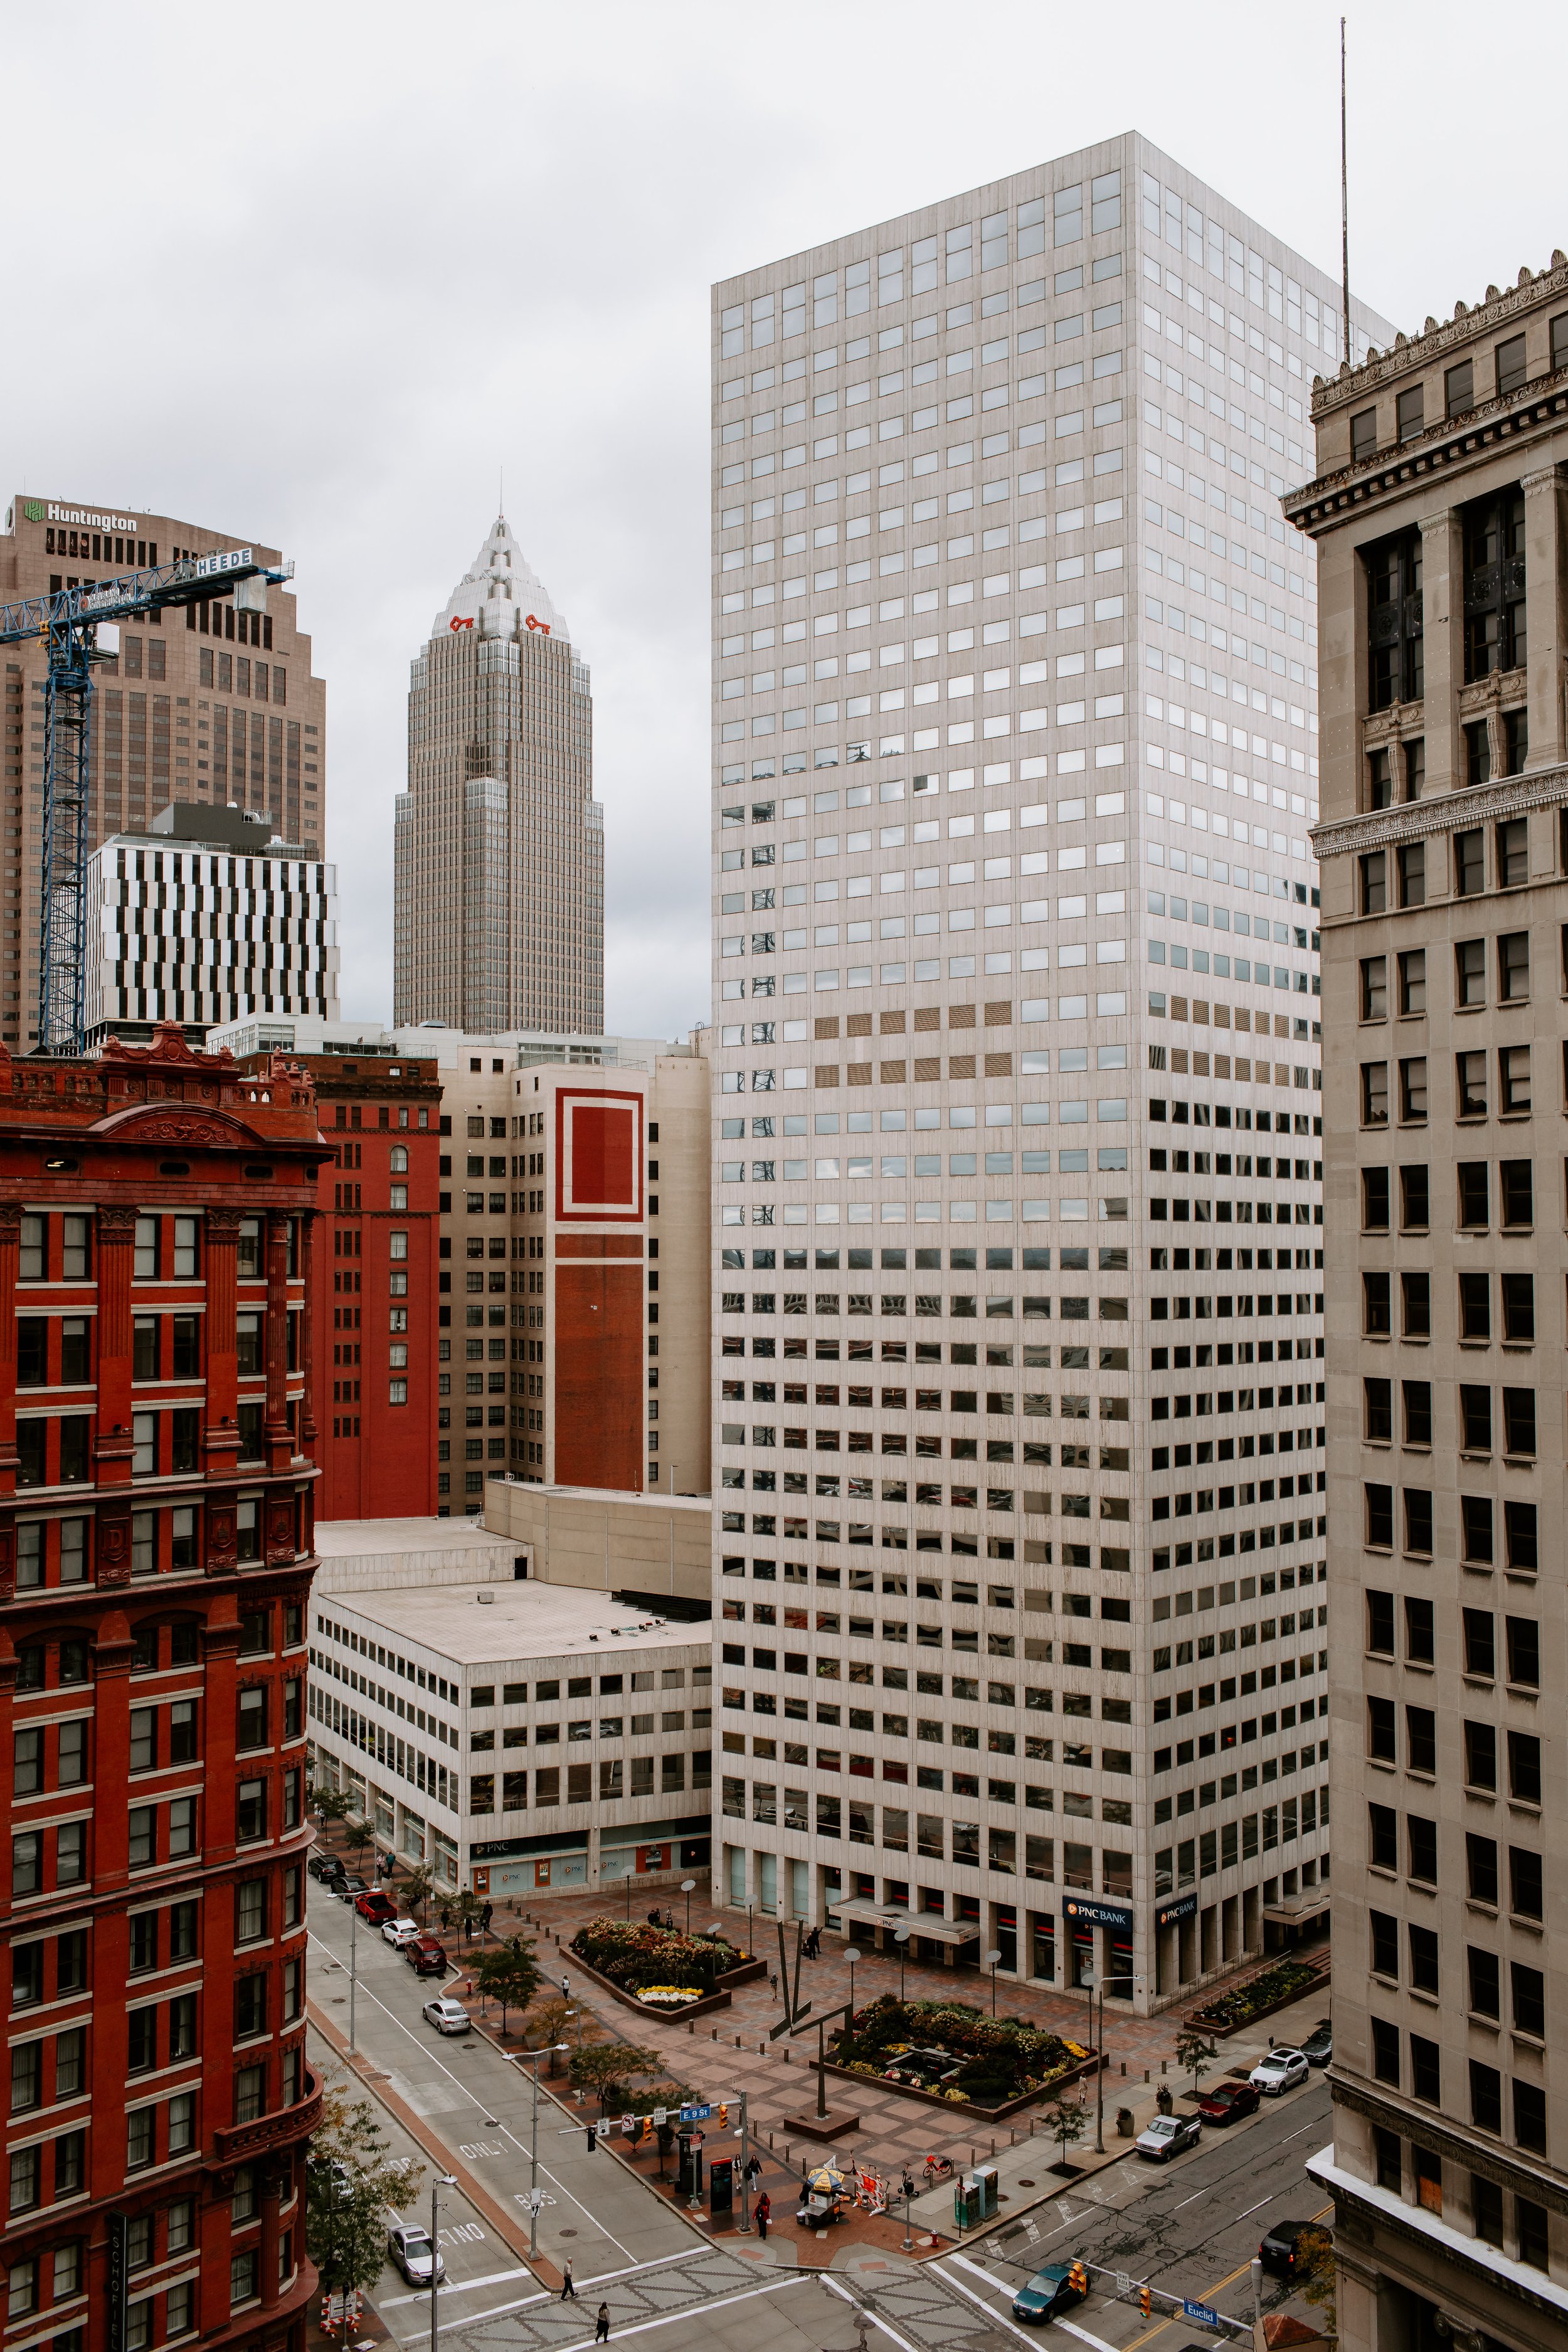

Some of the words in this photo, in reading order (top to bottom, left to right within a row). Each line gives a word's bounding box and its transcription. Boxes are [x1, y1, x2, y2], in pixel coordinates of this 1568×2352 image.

[48, 504, 137, 532] Huntington
[199, 549, 250, 576] HEEDE
[90, 588, 120, 601] CLEVELAND
[487, 1842, 509, 1853] PNC
[1078, 1905, 1099, 1919] PNC
[1099, 1910, 1126, 1925] BANK
[1167, 1907, 1179, 1920] PNC
[1179, 1900, 1194, 1915] BANK
[882, 1920, 894, 1928] PNC
[692, 2110, 697, 2118] 9
[699, 2109, 707, 2117] St
[459, 2139, 508, 2159] ONLY
[1188, 2304, 1213, 2322] Euclid
